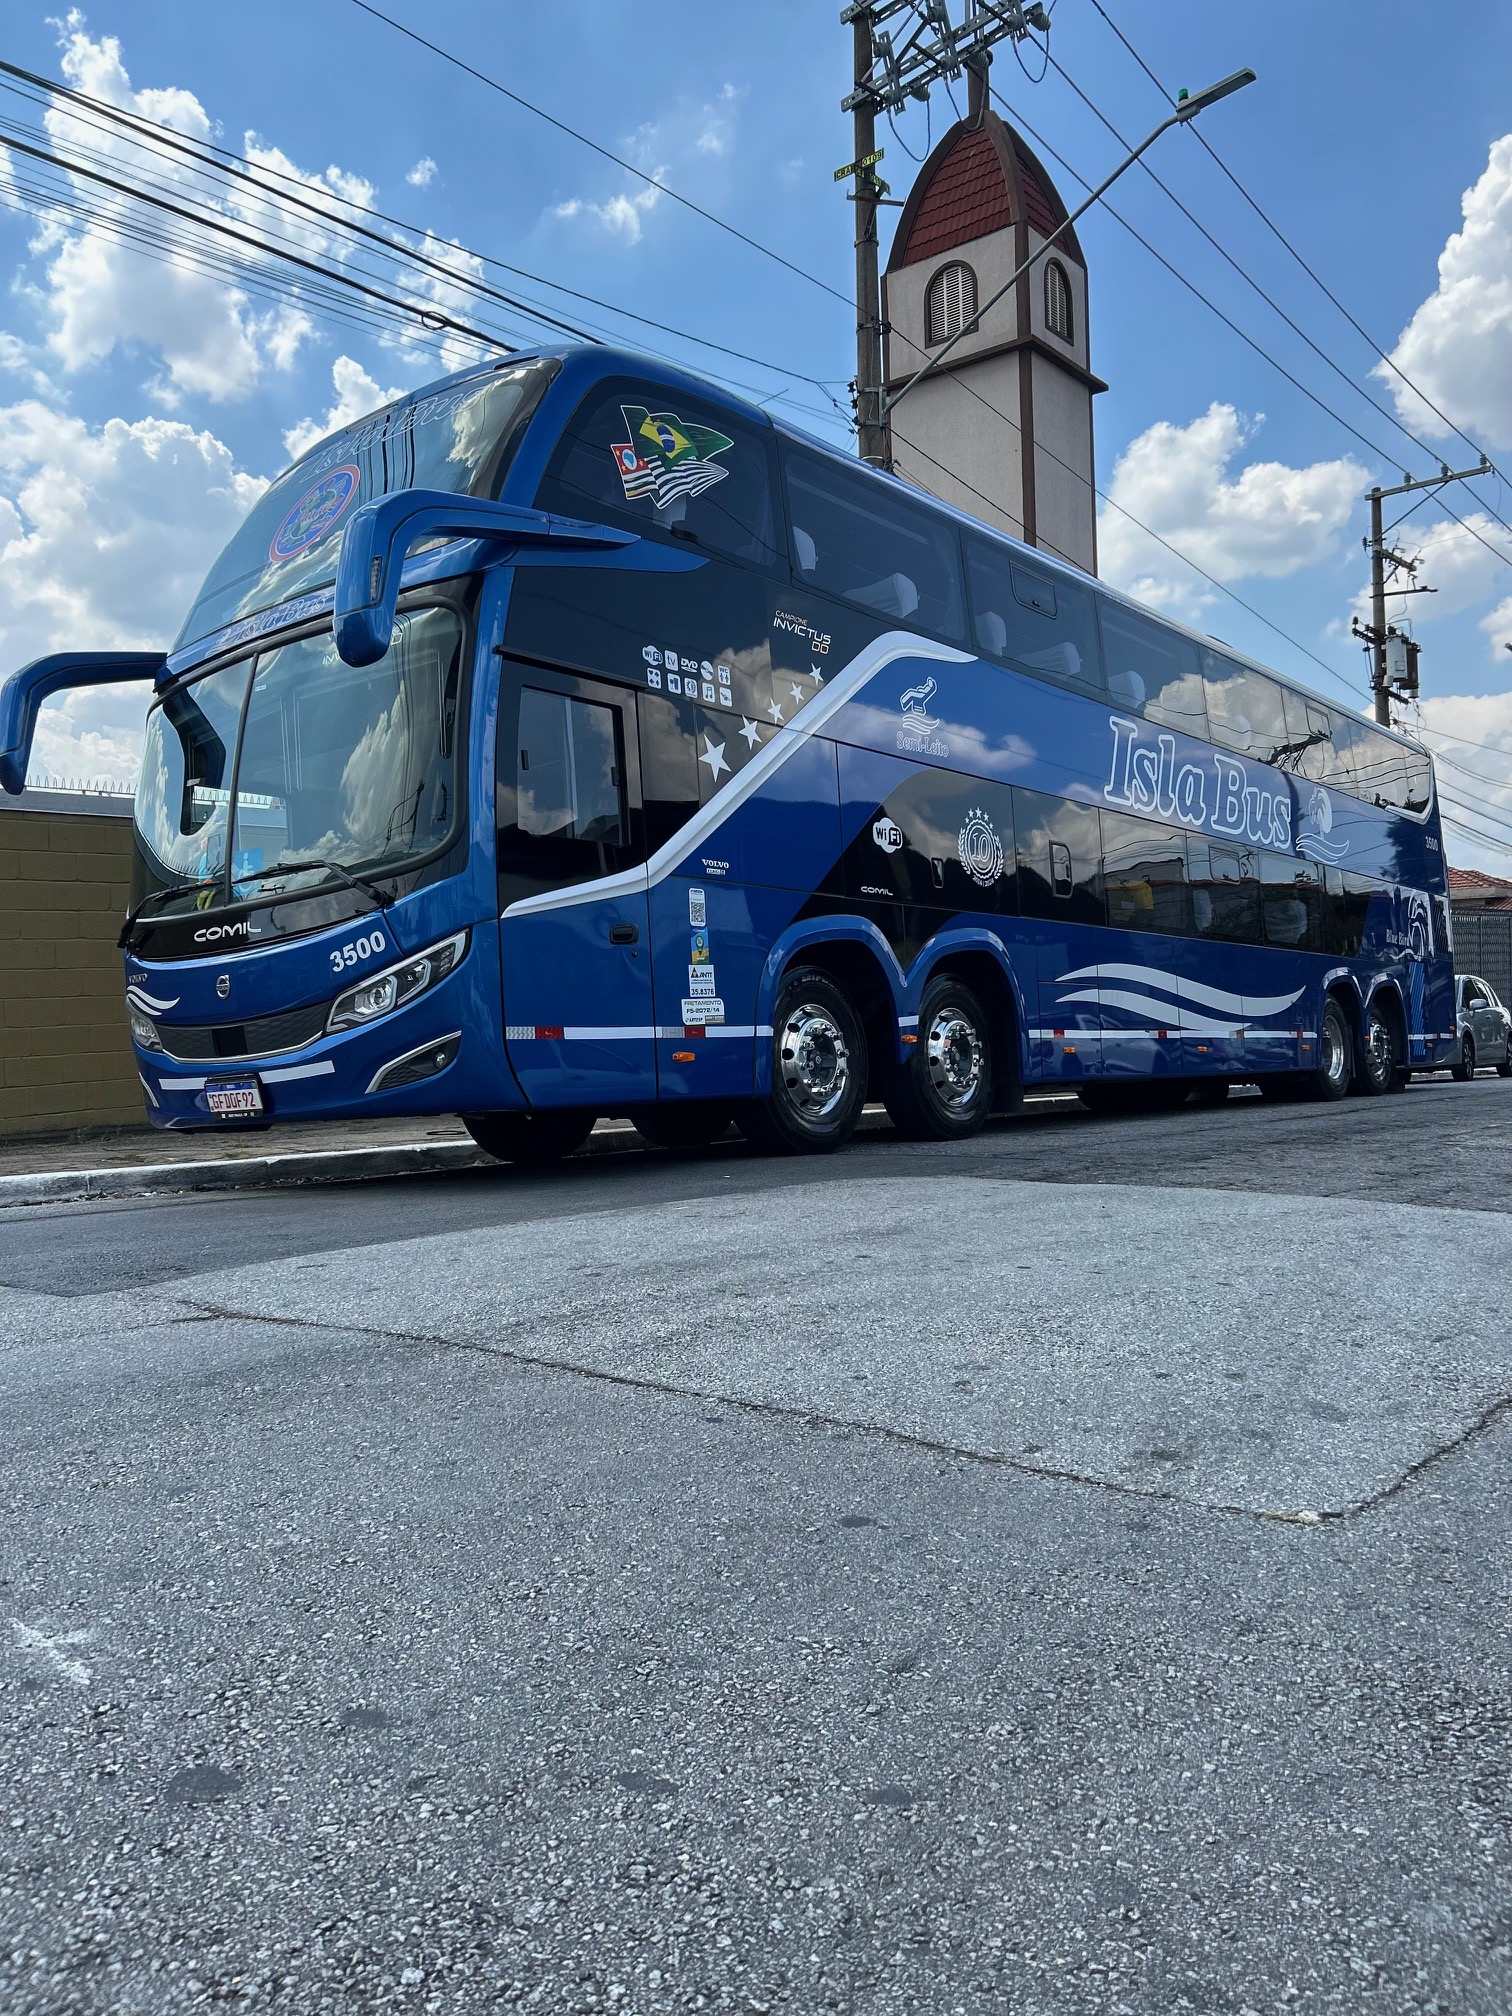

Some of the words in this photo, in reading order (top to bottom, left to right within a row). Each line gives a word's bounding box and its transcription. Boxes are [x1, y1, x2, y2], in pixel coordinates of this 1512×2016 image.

[775, 610, 808, 626] CAMPIONE
[773, 617, 831, 645] INVICTUS
[680, 657, 698, 669] DVD
[719, 666, 729, 674] WC
[896, 731, 949, 757] Semi-Leito
[1104, 715, 1206, 825] Isla
[1211, 753, 1292, 849] Bus
[971, 832, 992, 863] 10
[1425, 835, 1439, 852] 3500
[701, 858, 730, 869] VOLVO
[860, 885, 894, 896] COMIL
[194, 921, 262, 943] COMIL
[329, 930, 386, 973] 3500
